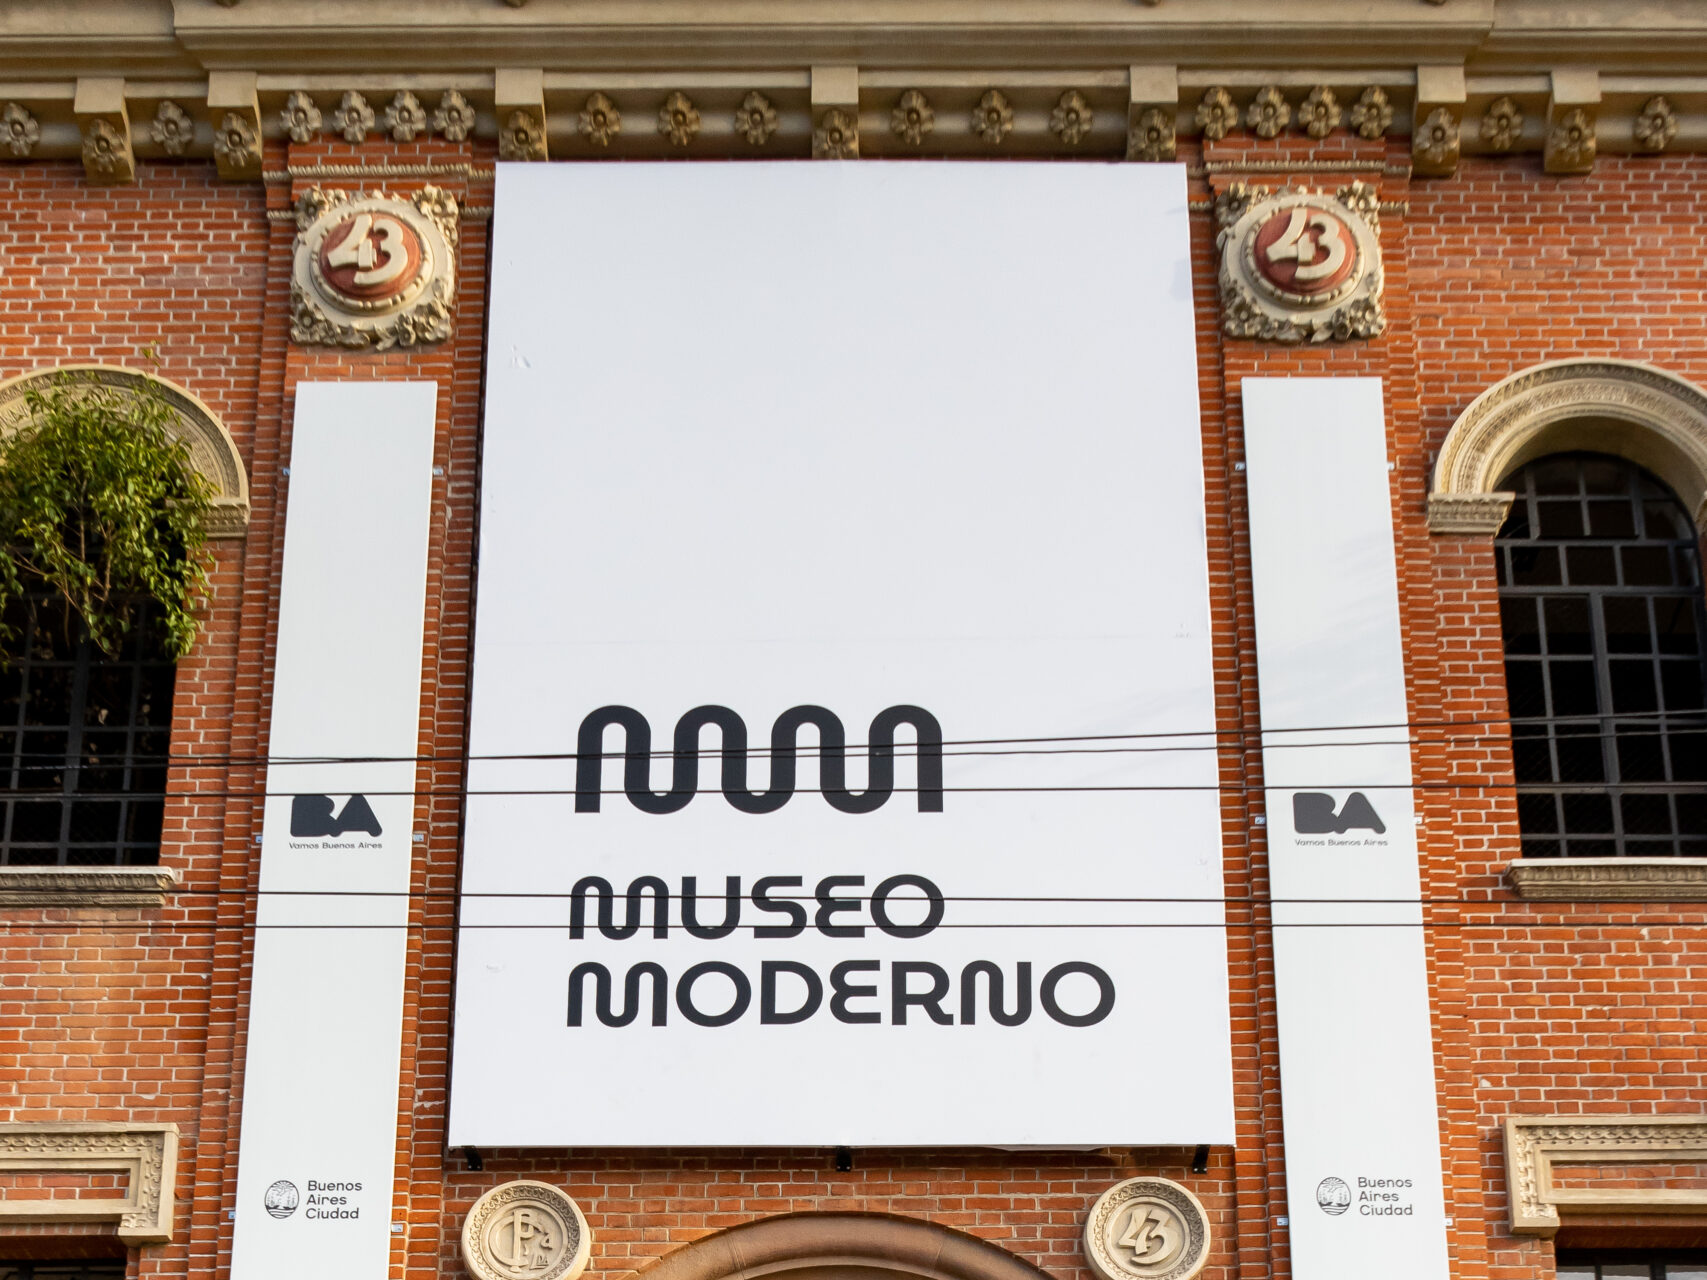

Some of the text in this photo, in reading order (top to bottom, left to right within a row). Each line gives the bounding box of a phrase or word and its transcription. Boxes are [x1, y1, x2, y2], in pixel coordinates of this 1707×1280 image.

[289, 841, 383, 849] Vamos Buenos Aires
[569, 874, 945, 940] MUSEO
[566, 960, 1116, 1028] MODERNO
[307, 1180, 363, 1191] Buenos
[1358, 1177, 1413, 1188] Buenos
[306, 1194, 347, 1206] Aires
[1358, 1191, 1400, 1202] Aires
[305, 1208, 360, 1220] Ciudad
[1359, 1205, 1413, 1216] Ciudad
